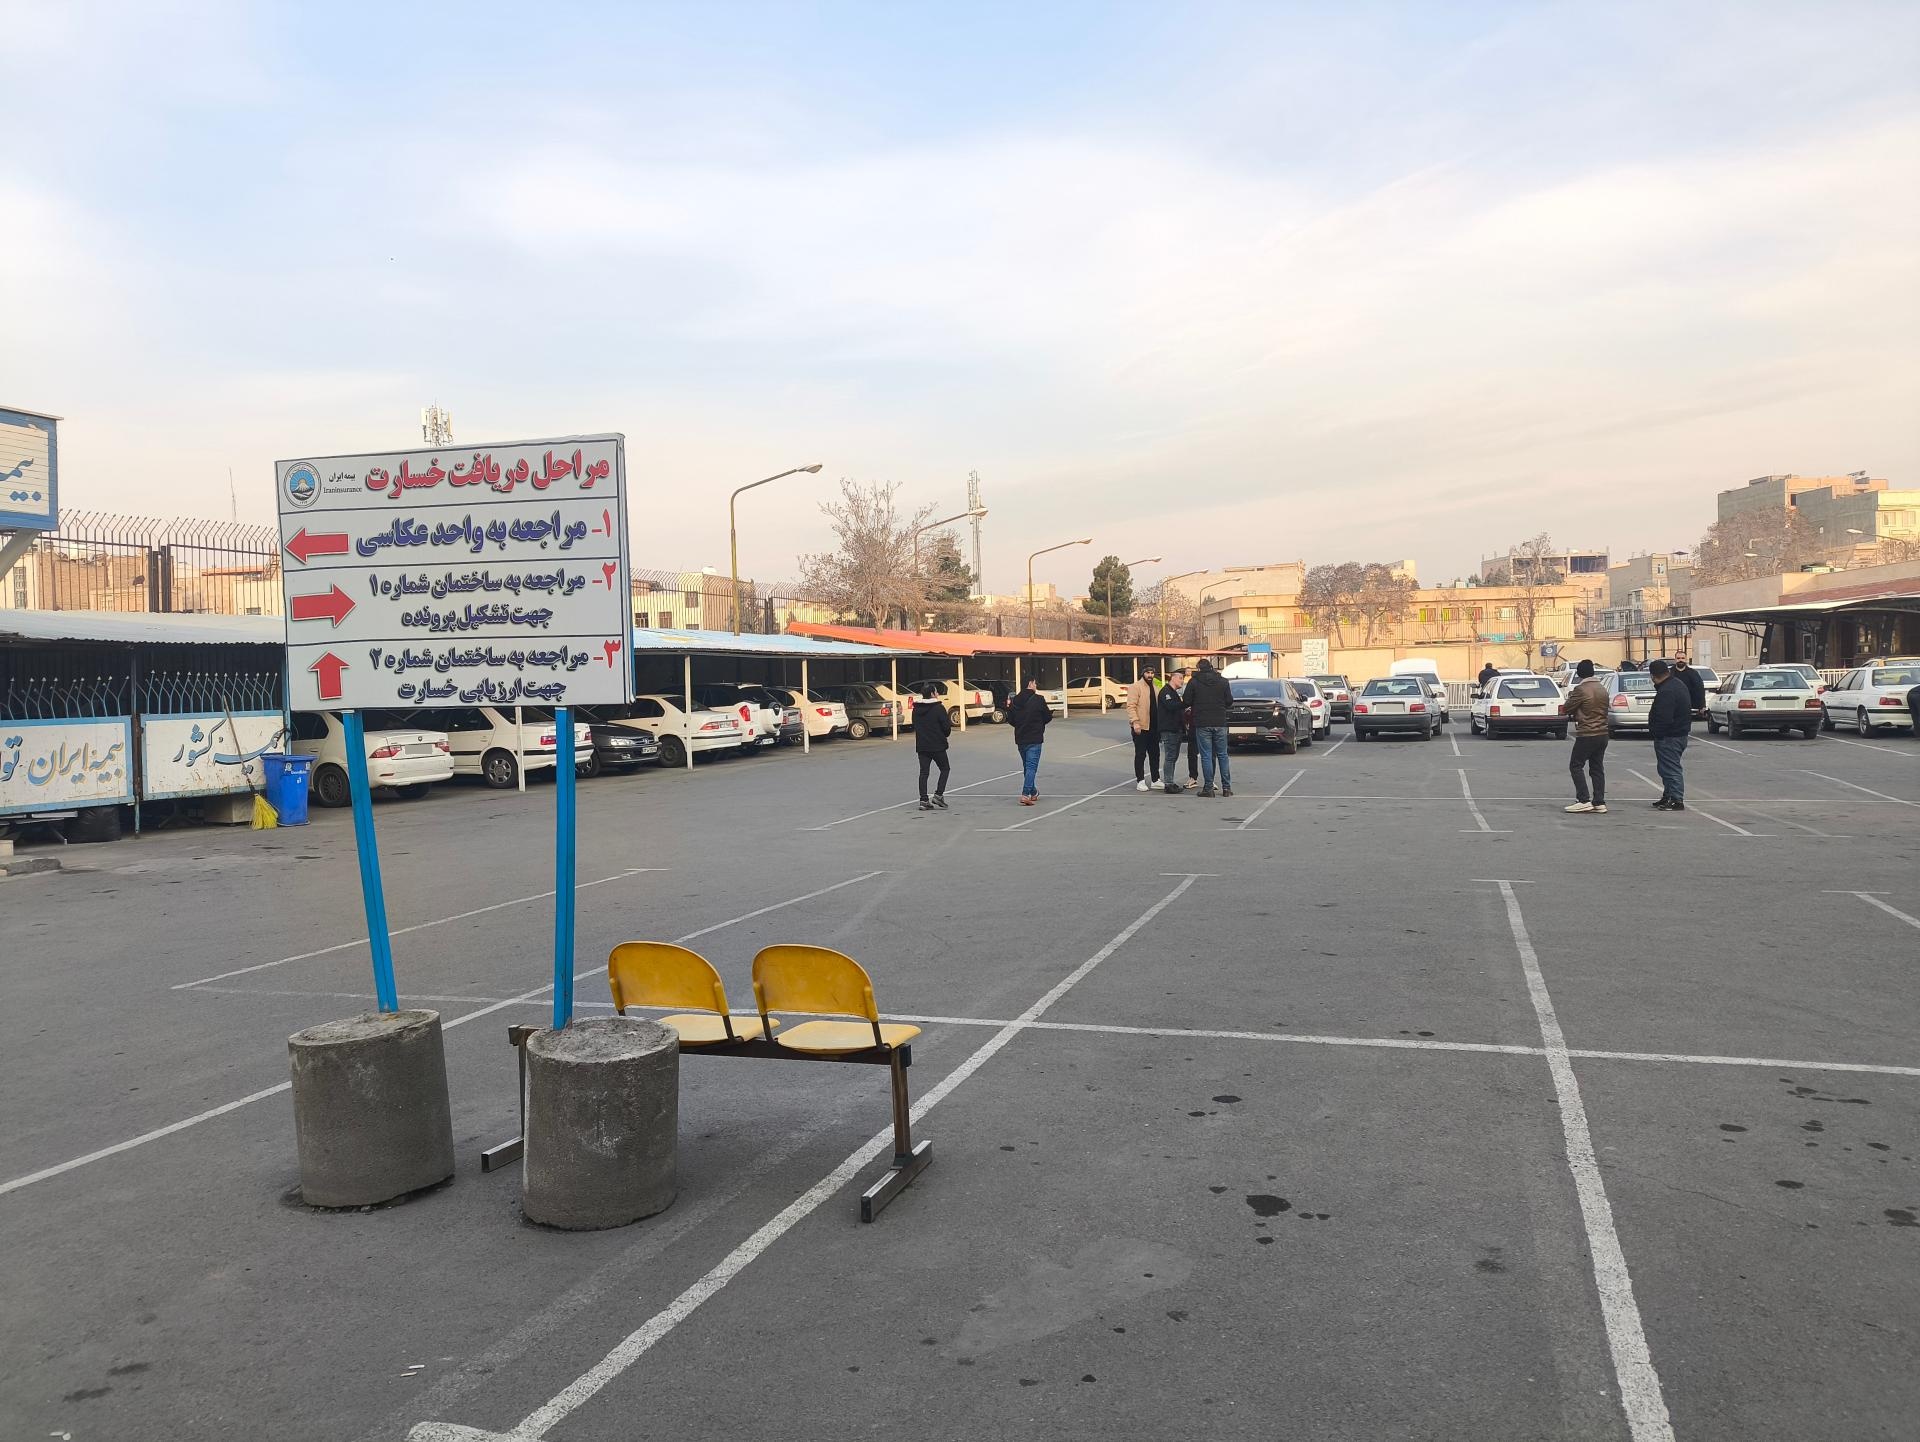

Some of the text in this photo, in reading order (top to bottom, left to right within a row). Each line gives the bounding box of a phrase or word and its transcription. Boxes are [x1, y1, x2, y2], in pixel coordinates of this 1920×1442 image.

[0, 457, 42, 502] بیم
[328, 472, 356, 483] بیمه ایران
[366, 457, 447, 499] خسارت
[449, 452, 530, 493] دریافت
[532, 448, 610, 489] مراحل
[357, 517, 430, 556] عکاسی
[430, 513, 486, 552] واحد
[485, 519, 508, 550] به
[509, 509, 588, 549] مراجعه
[381, 571, 431, 601] شماره
[431, 570, 502, 600] ساختمان
[503, 574, 524, 596] به
[523, 567, 586, 597] مراجعه
[400, 600, 554, 633] جهت تشکیل پرونده
[383, 647, 434, 674] شماره
[434, 645, 506, 673] ساختمان
[506, 649, 526, 671] به
[526, 645, 589, 672] مراجعه
[398, 676, 567, 704] جهت ارزیابی خسارت
[0, 735, 23, 782] تو
[172, 717, 228, 768] کشور
[27, 741, 90, 787] ایران
